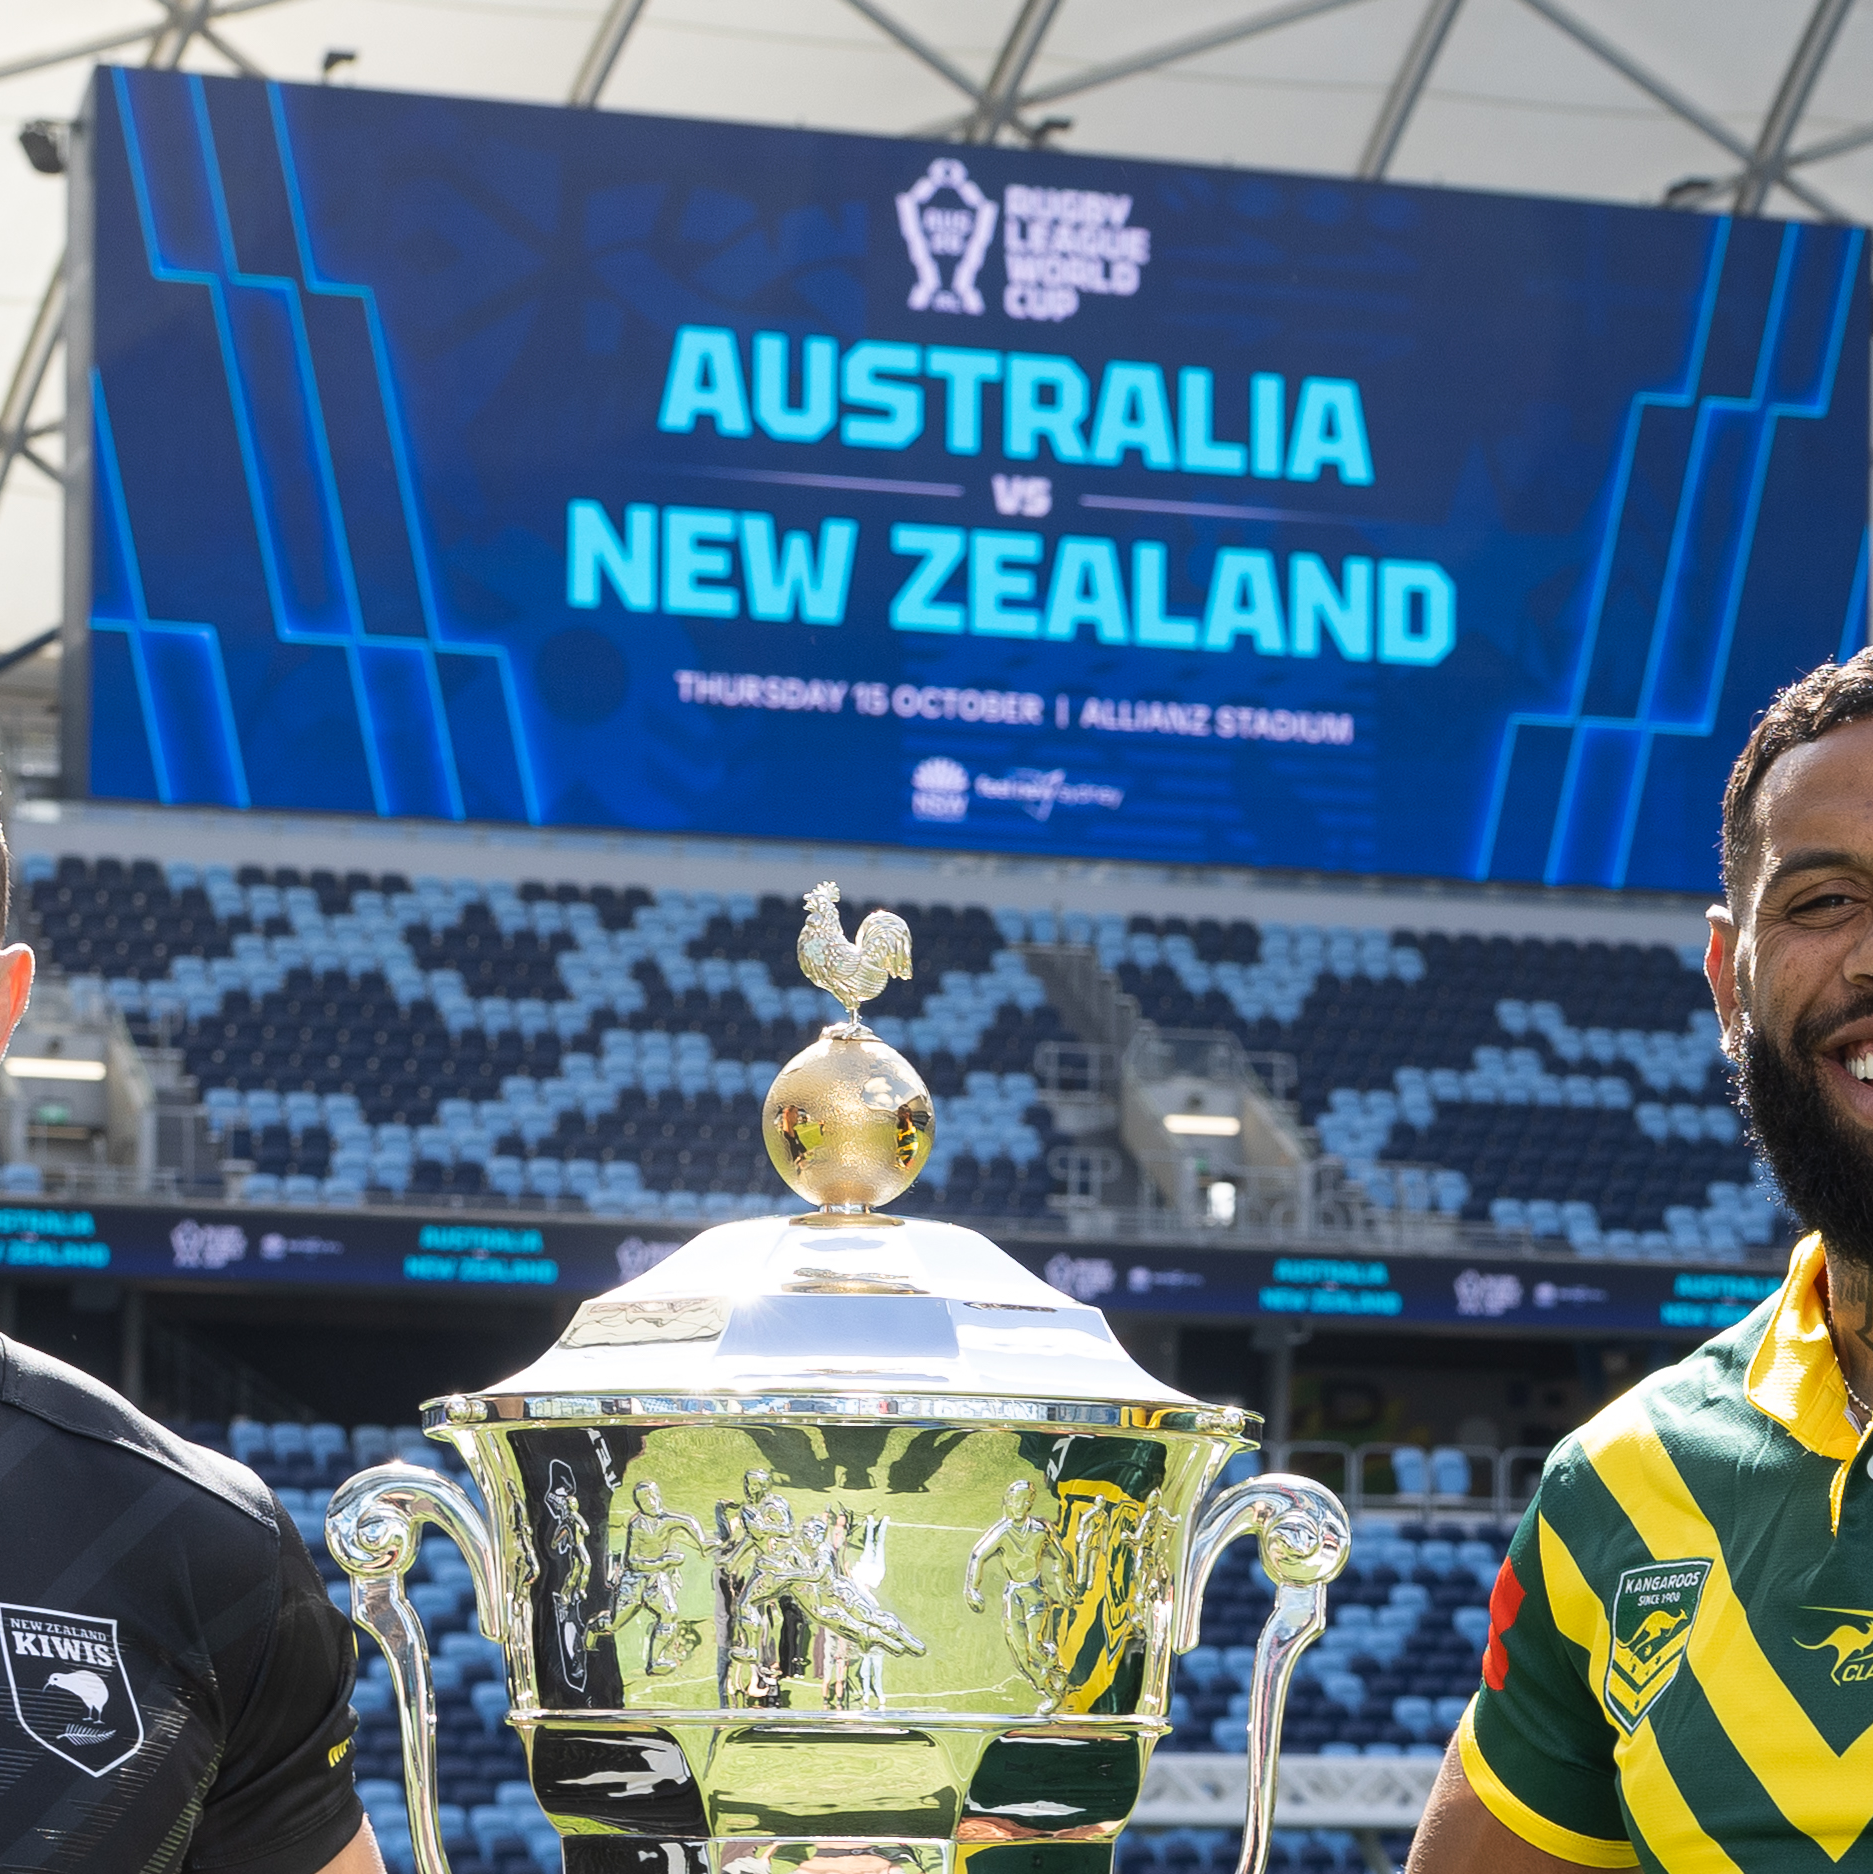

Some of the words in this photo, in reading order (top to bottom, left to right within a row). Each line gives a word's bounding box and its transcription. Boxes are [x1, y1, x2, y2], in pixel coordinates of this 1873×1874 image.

[657, 323, 1375, 487] AUSTRALIA
[992, 474, 1052, 518] VS
[566, 498, 859, 627] NEW
[889, 522, 1457, 667] ZEALAND
[673, 669, 848, 713] THURSDAY
[851, 681, 889, 716] 15
[891, 683, 1044, 726] OCTOBER
[1079, 697, 1211, 737] ALLIANZ
[1214, 705, 1354, 745] STADIUM
[1625, 1571, 1701, 1594] KANGAROOS
[1637, 1593, 1660, 1607] SINCE
[10, 1618, 44, 1633] NEW
[46, 1622, 108, 1642] ZEALAND
[11, 1631, 114, 1667] KIWIS
